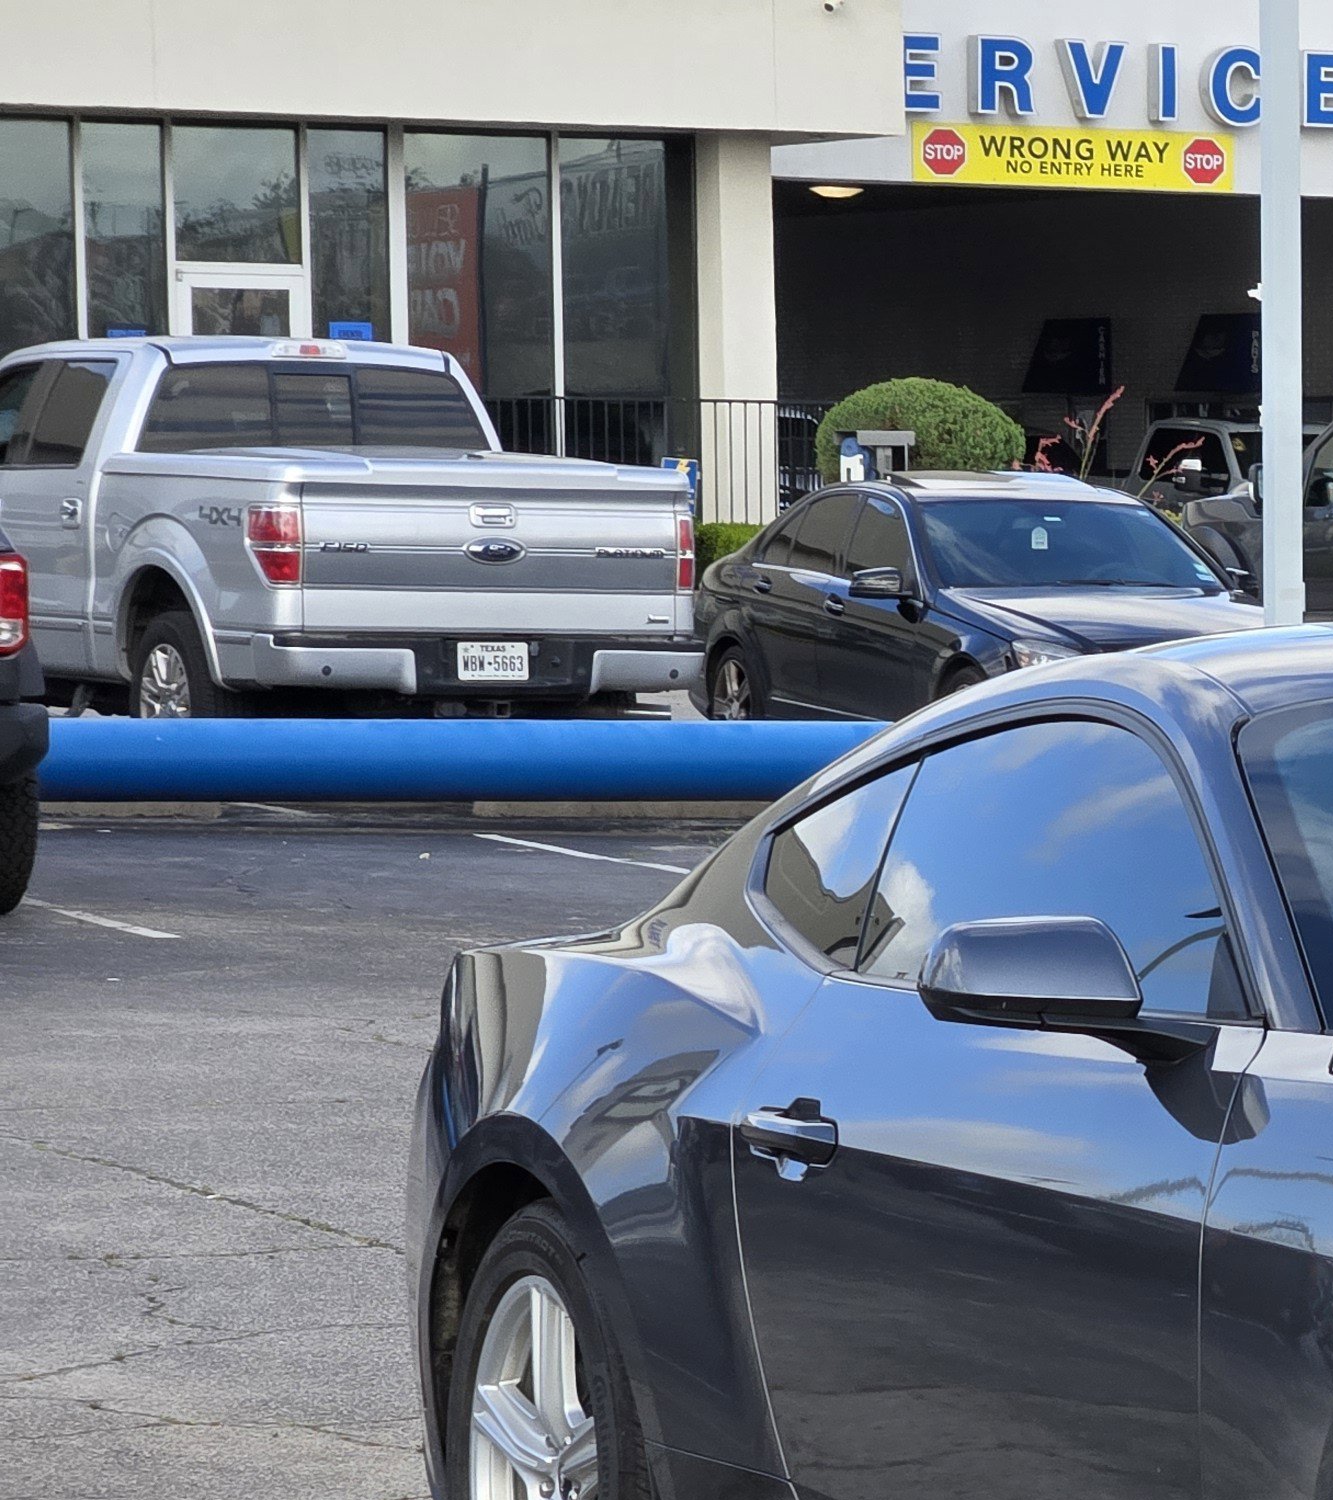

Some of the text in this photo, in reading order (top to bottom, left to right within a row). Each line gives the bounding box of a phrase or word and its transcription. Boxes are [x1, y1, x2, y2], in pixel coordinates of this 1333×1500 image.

[924, 144, 964, 160] STOP
[979, 135, 1170, 163] WRONG WAY
[1006, 160, 1144, 178] NO ENTRY HERE
[1185, 153, 1223, 170] STOP
